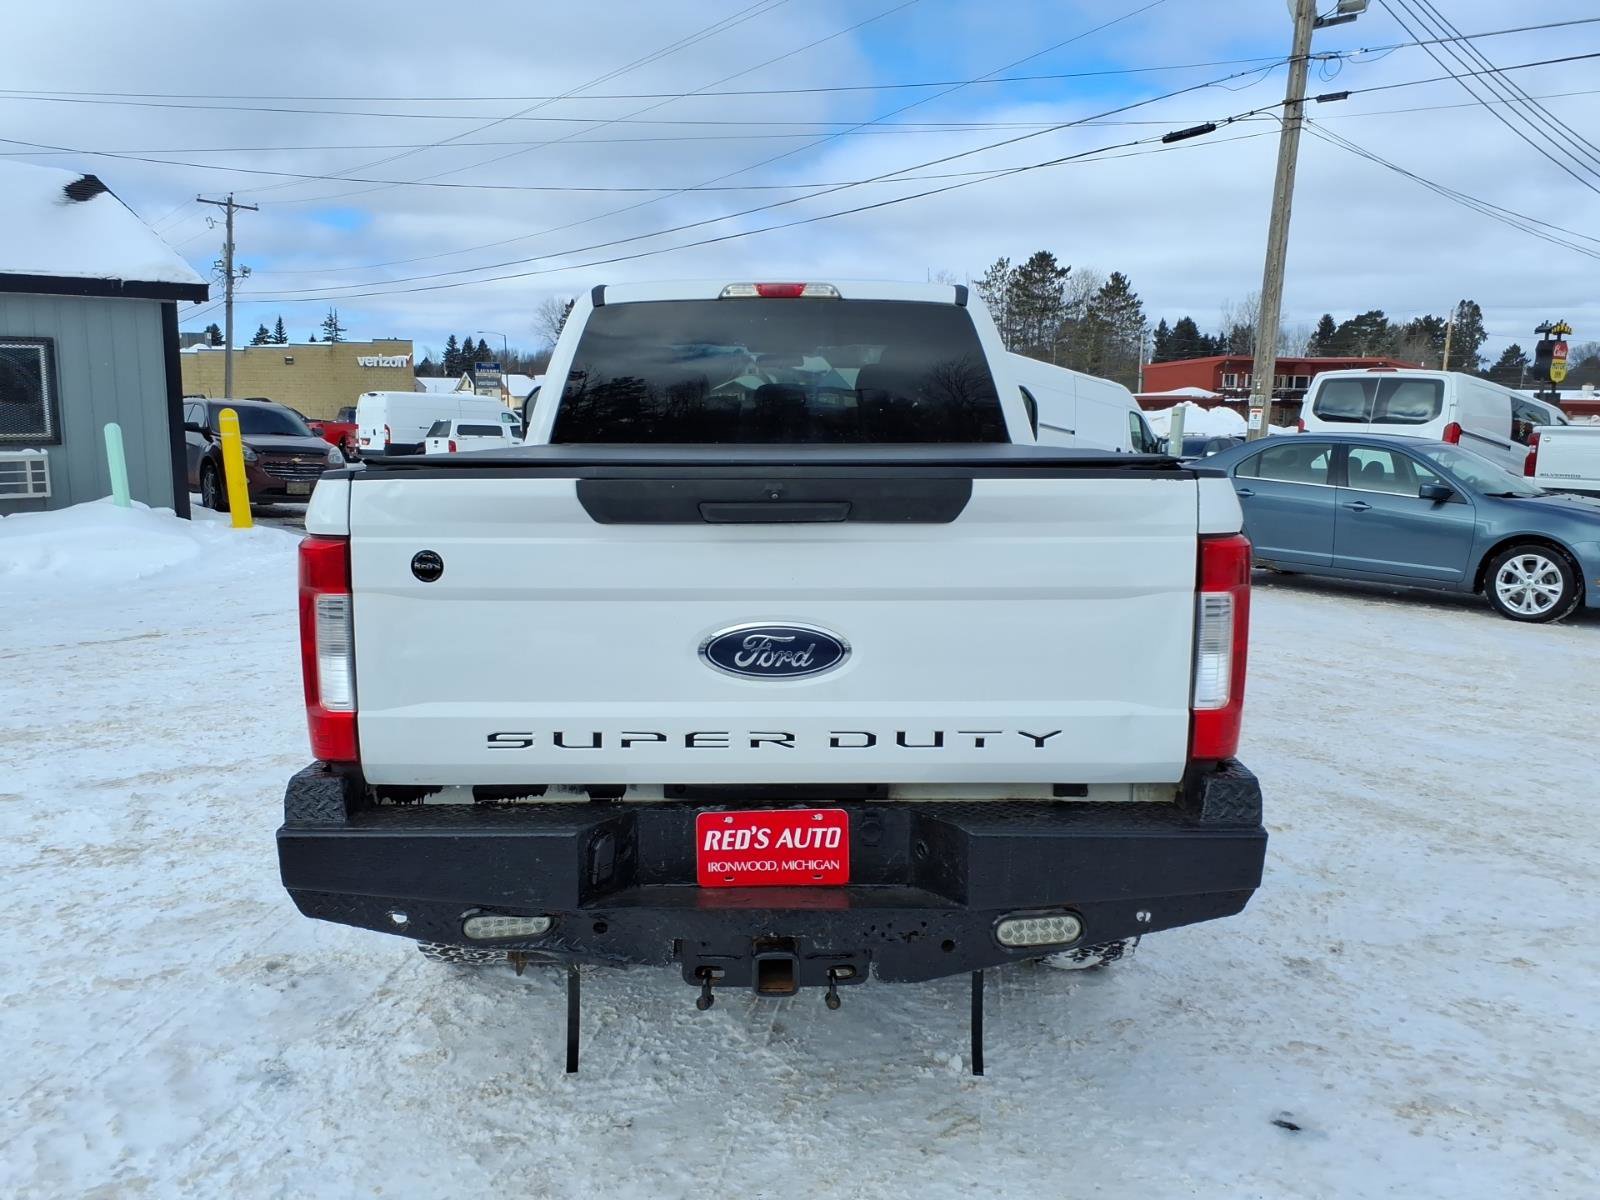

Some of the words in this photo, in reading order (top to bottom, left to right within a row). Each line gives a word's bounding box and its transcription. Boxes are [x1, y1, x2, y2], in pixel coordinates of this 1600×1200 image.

[356, 353, 407, 368] verizon
[734, 634, 816, 667] Ford
[486, 731, 796, 749] SUPER
[829, 729, 1063, 749] DUTY
[703, 825, 772, 851] RED'S
[774, 826, 842, 849] AUTO
[707, 860, 779, 873] IRONWOOD,
[781, 859, 840, 871] MICHIGAN
